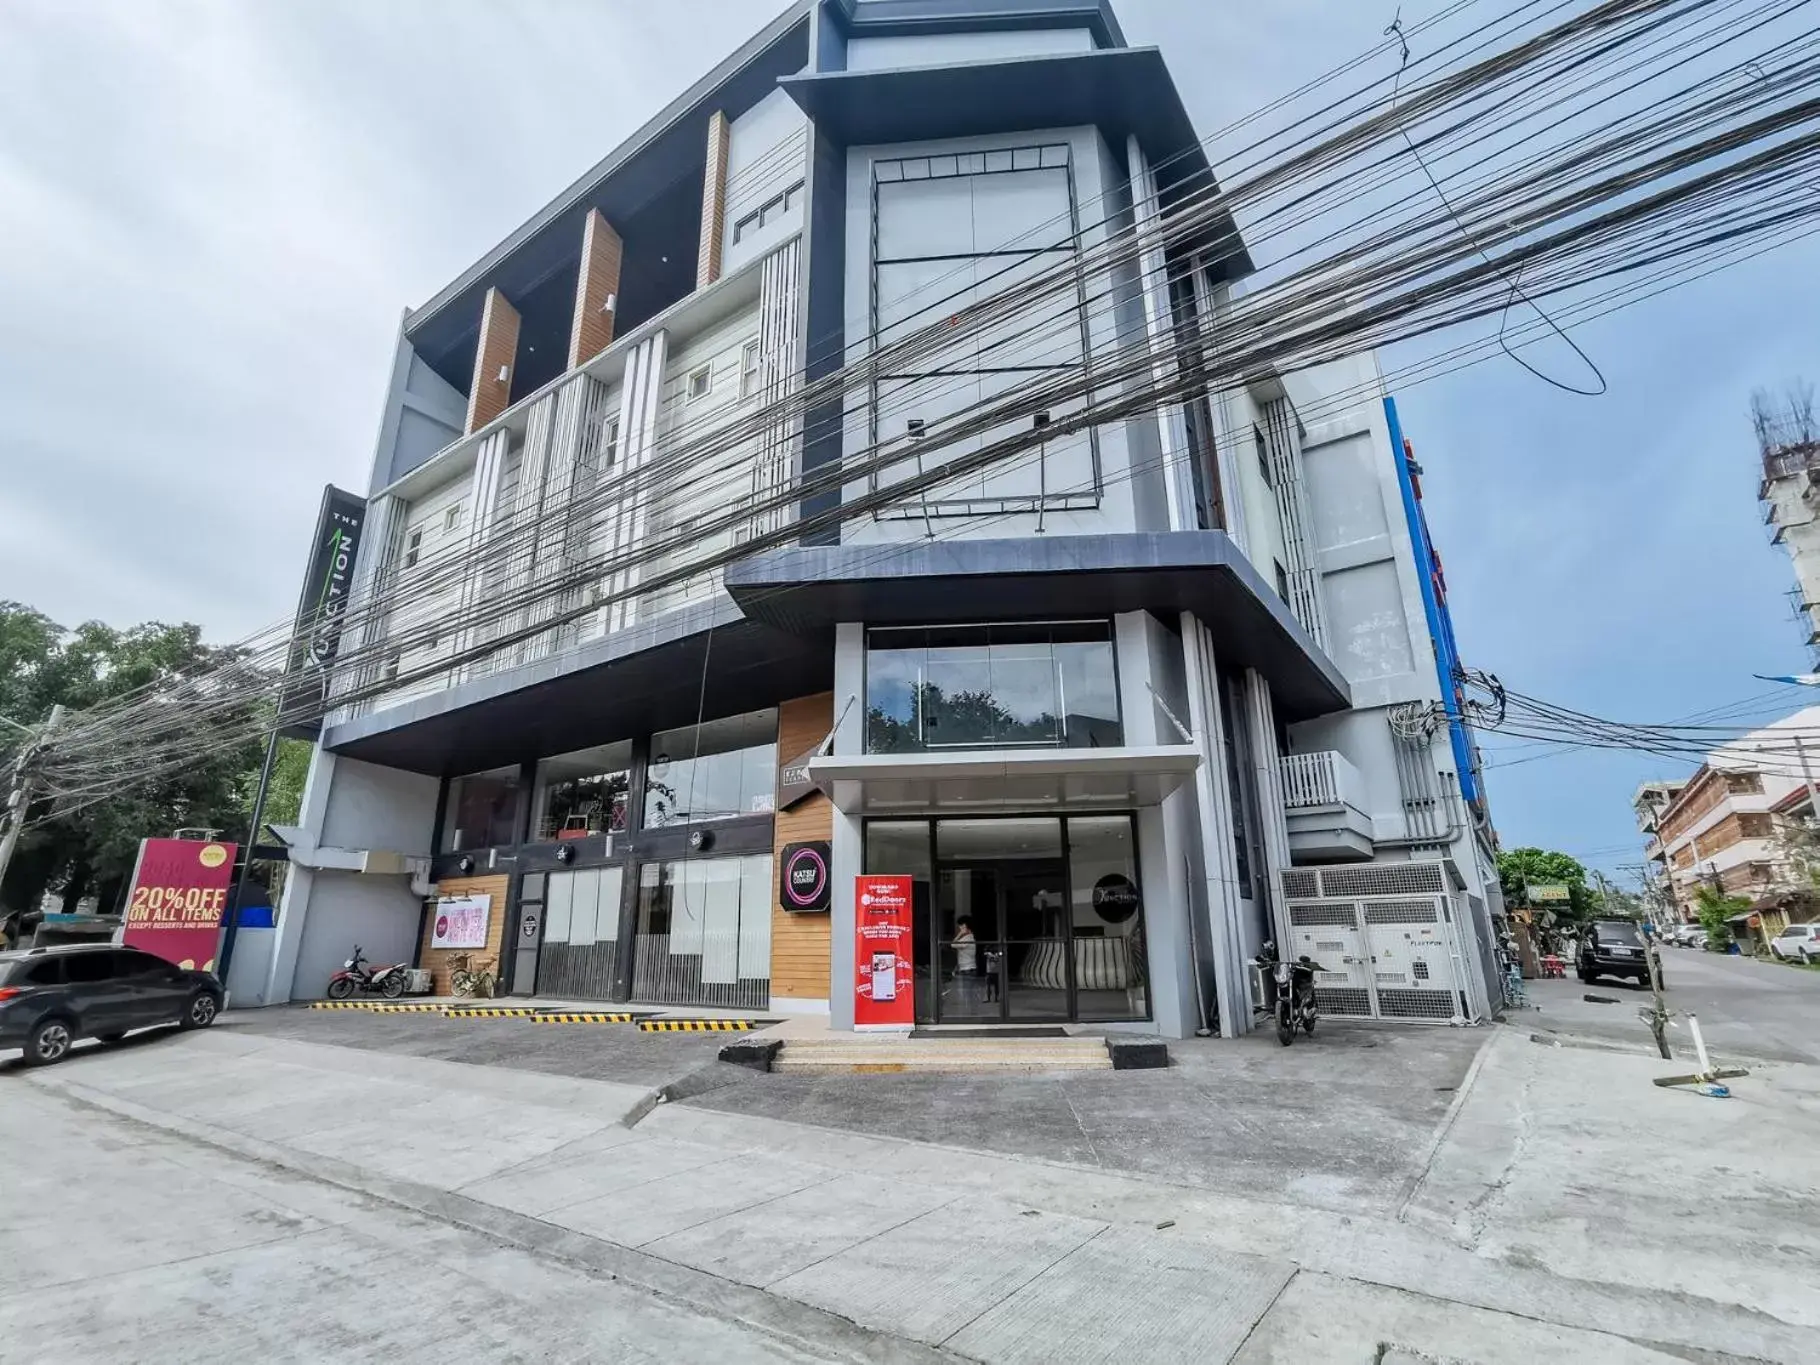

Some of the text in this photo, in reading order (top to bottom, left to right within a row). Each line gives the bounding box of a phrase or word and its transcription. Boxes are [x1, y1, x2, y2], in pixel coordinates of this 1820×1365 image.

[333, 512, 358, 527] THE
[129, 907, 221, 922] ON ALL ITEMS
